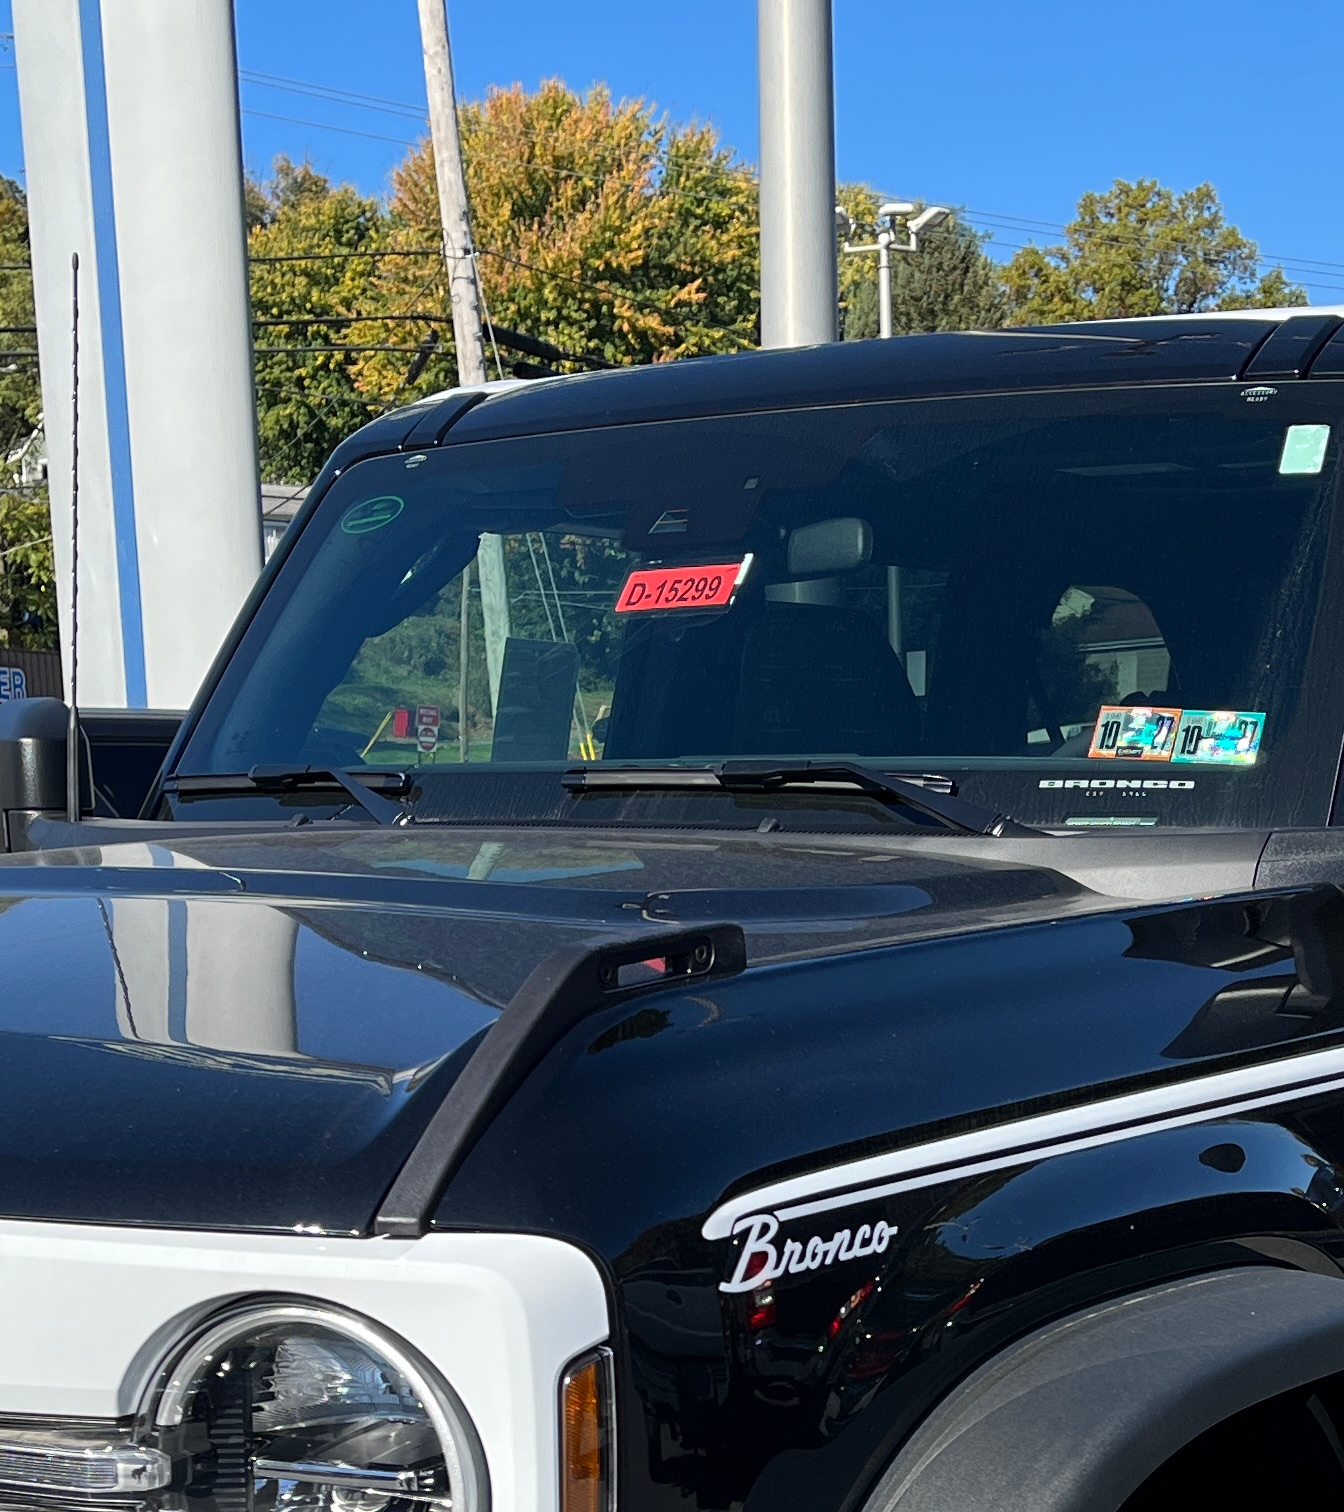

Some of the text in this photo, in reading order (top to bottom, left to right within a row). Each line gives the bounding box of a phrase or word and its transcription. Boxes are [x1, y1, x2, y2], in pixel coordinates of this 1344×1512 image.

[626, 576, 722, 606] D-15299
[1038, 780, 1196, 789] BRONCO
[718, 1213, 898, 1293] Bronco
